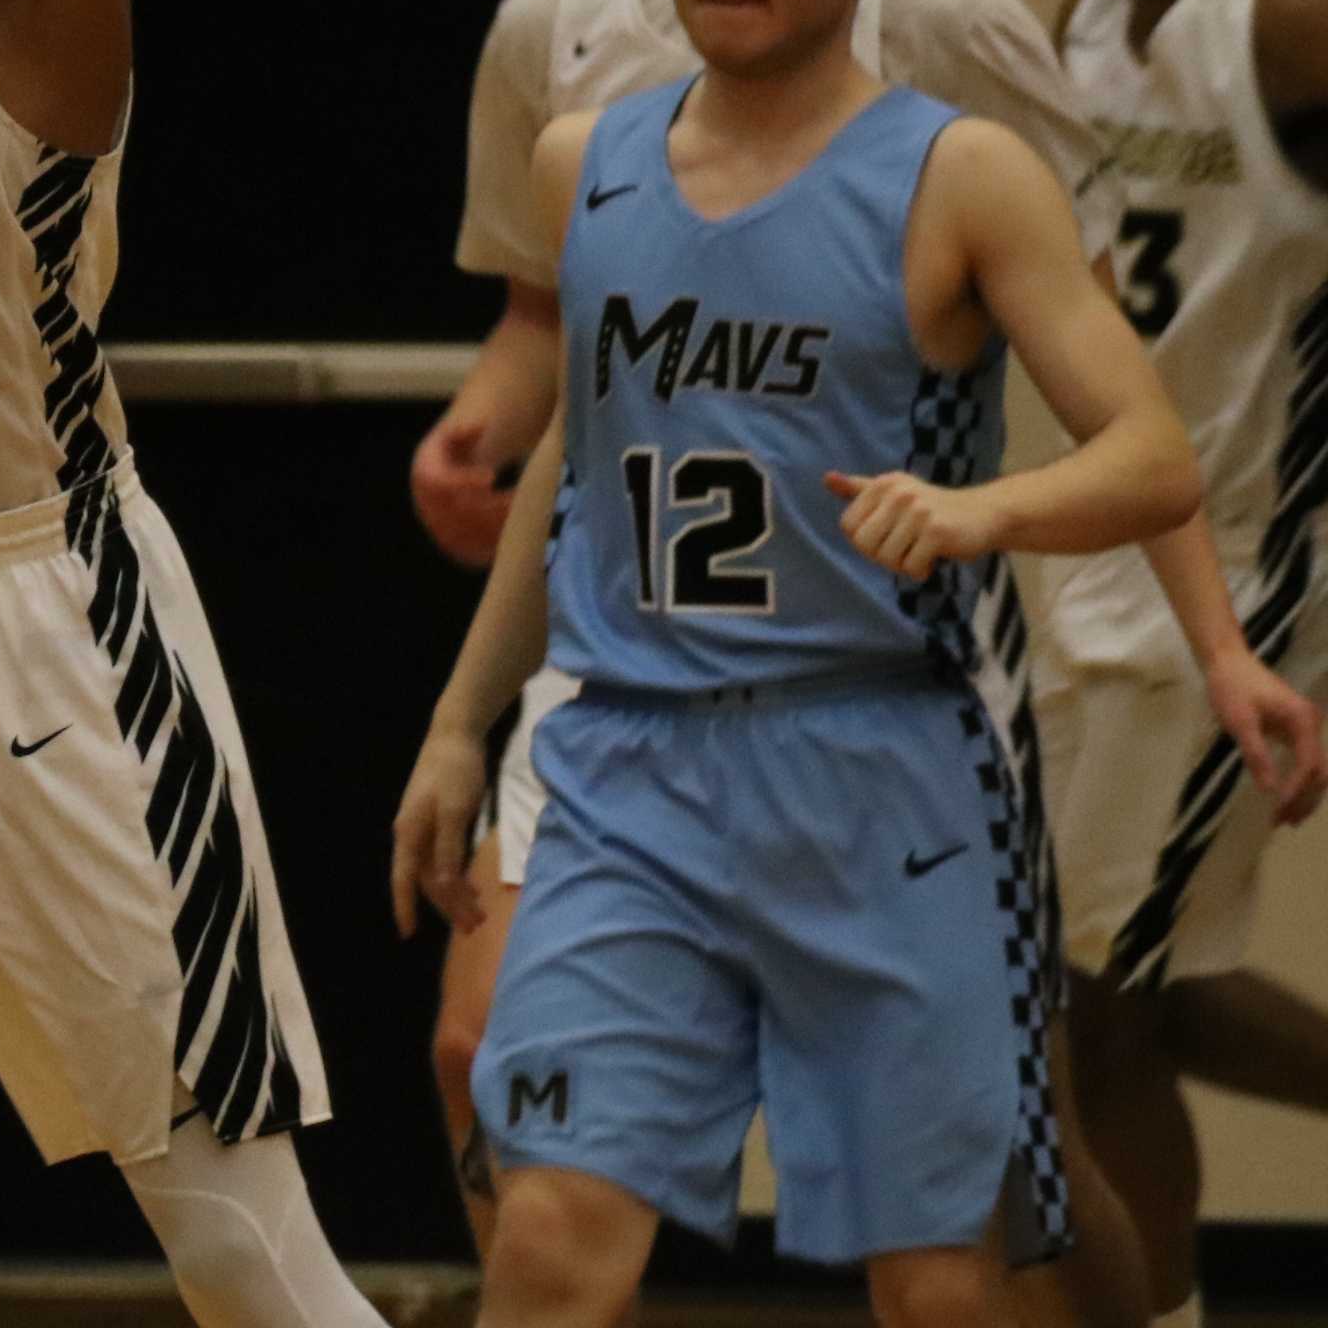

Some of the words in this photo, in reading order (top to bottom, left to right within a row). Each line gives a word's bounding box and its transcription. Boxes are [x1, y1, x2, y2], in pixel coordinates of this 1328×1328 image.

[594, 293, 831, 405] MAVS
[620, 446, 777, 616] 12
[507, 1070, 569, 1127] M
